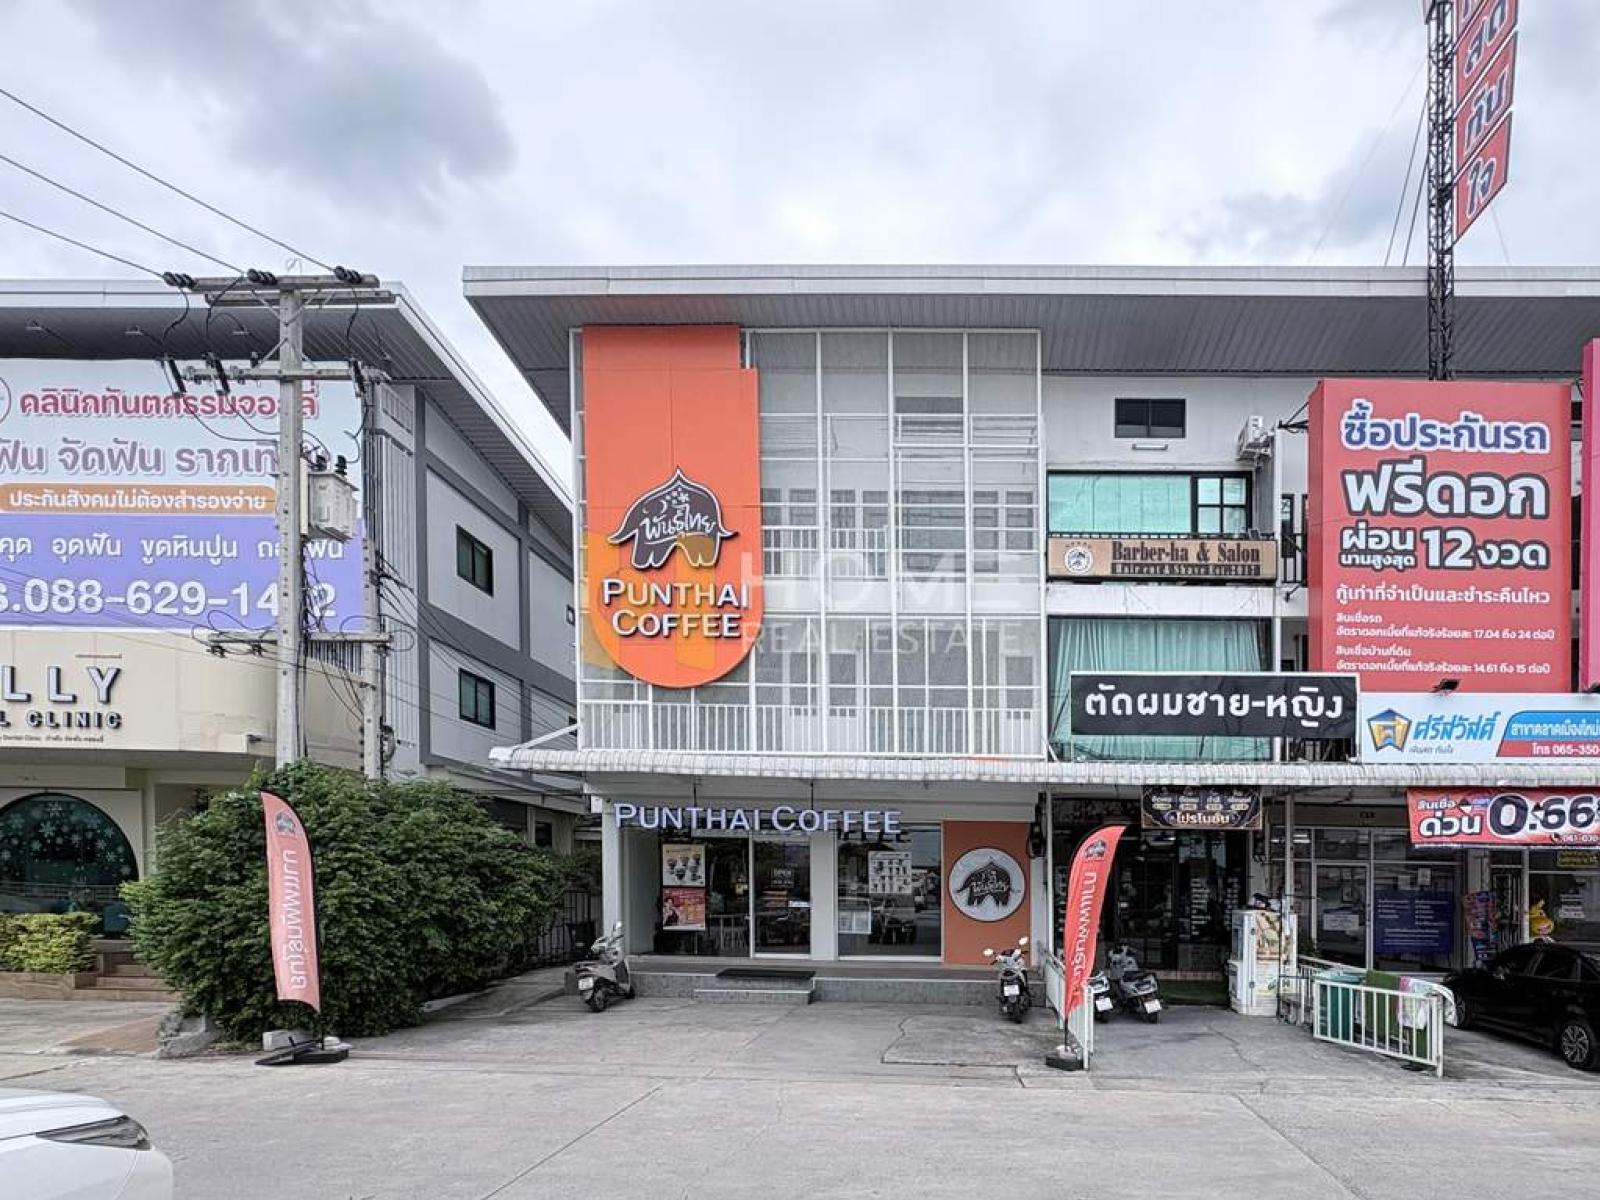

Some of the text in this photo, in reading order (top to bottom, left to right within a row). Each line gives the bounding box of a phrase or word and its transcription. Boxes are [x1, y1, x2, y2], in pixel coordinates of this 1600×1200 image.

[20, 377, 319, 416] คลินิกทันตกรรมจอลี่
[1342, 402, 1549, 451] ซื้อประกันรถ
[58, 437, 163, 474] จัดฟัน
[9, 487, 267, 510] ประกันสังคมไม่ต้องสำรองจ่าย
[1342, 457, 1549, 517] ฟรีดอก
[52, 532, 122, 564] อุดฟัน
[140, 534, 238, 566] ขูดหินปูน
[1342, 521, 1416, 550] ผ่อน
[1112, 541, 1260, 562] Barber-ha & Salon
[1341, 554, 1416, 571] นานสูงสุด
[602, 577, 750, 607] PUNTHAI
[1336, 582, 1550, 605] กู้เท่าที่จำเป็นและชำระคืนไหว
[611, 609, 742, 638] COFFEE
[1518, 629, 1531, 639] 24
[1516, 663, 1527, 673] 15
[26, 709, 122, 729] CLINIC
[1085, 683, 1343, 728] ตัดผมชาย-หญิง
[1413, 711, 1502, 741] ศรีสวัสดิ์
[613, 803, 902, 833] PUNTHAI COFFEE
[1419, 810, 1482, 838] ด่วน
